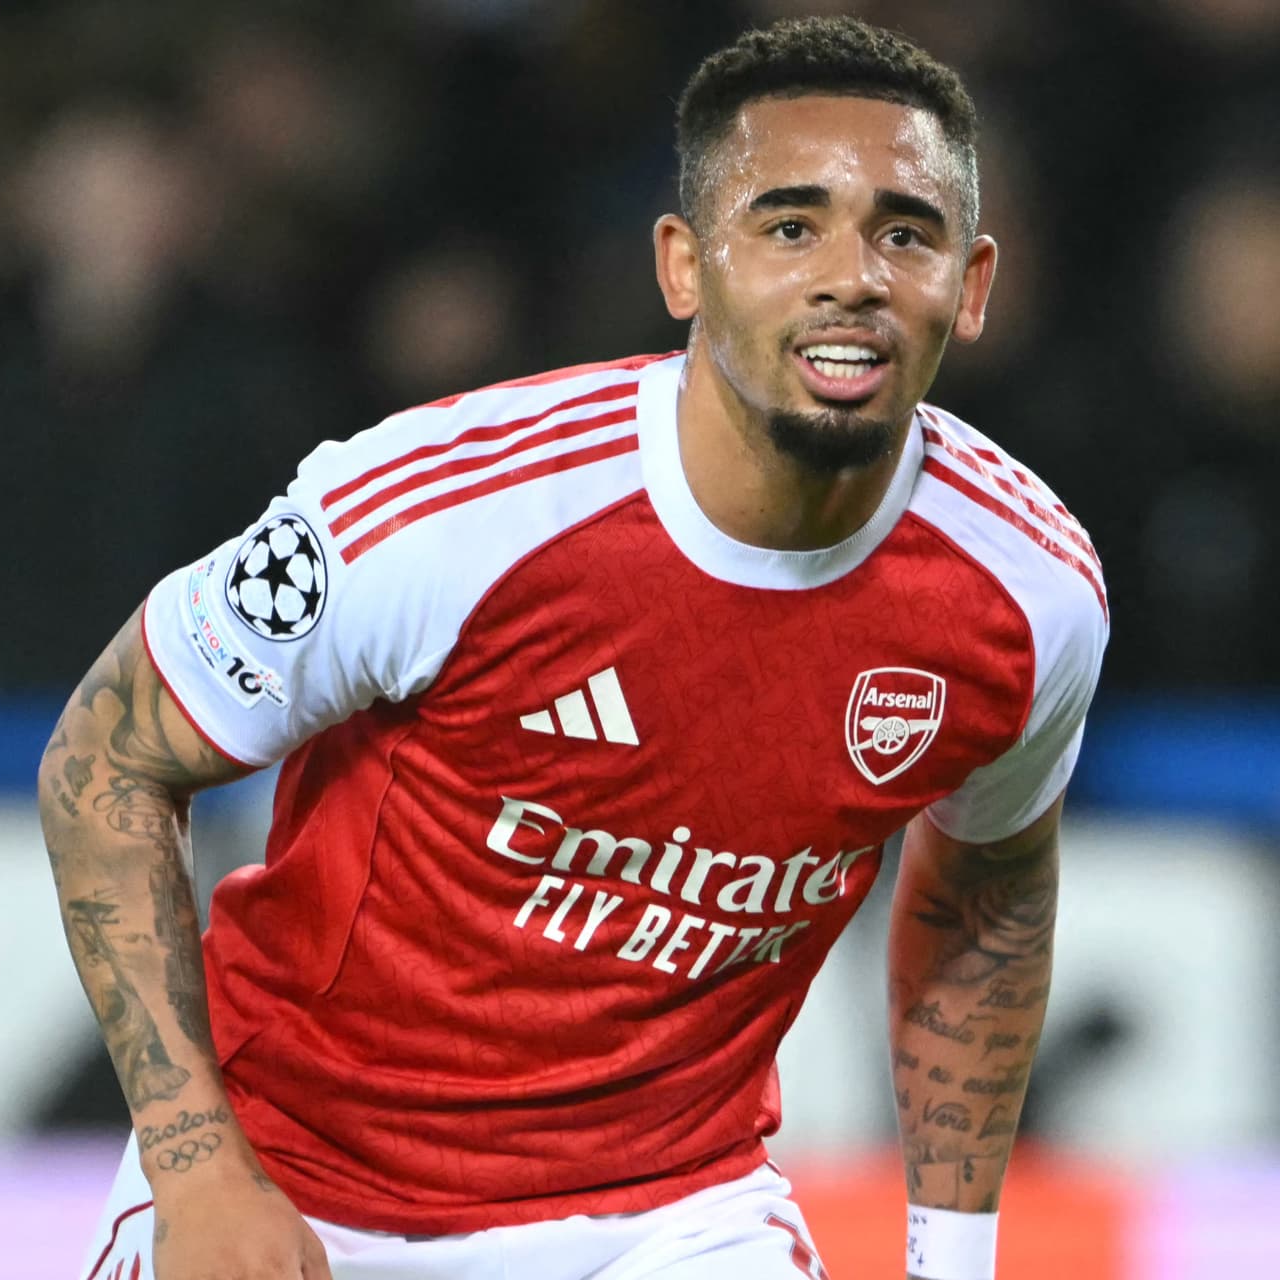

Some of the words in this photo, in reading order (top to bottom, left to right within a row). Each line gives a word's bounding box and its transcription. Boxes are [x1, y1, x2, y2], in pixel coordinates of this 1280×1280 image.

[226, 656, 263, 694] 10
[863, 687, 932, 709] Arsenal
[513, 874, 624, 951] FLY
